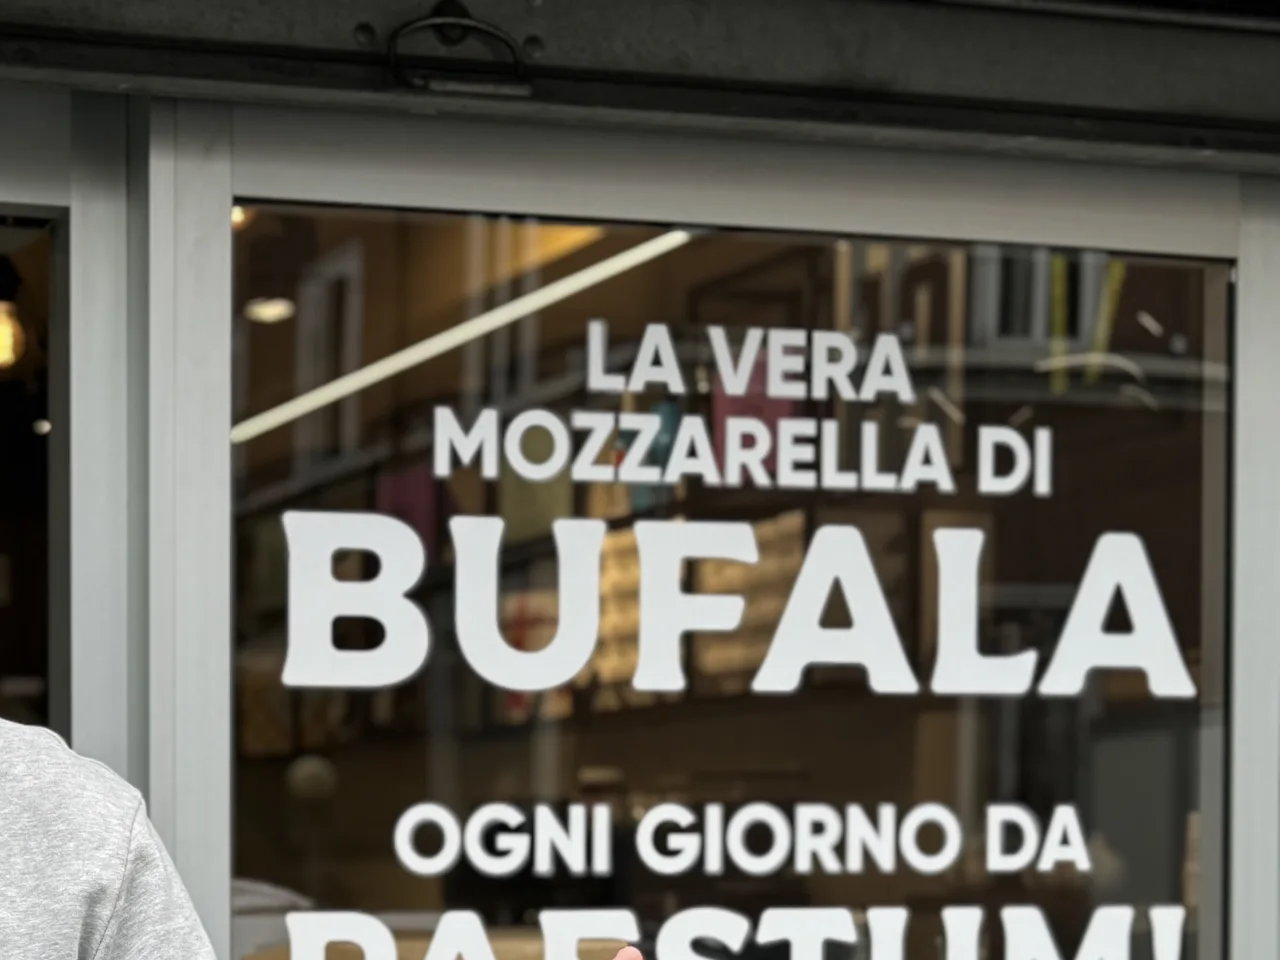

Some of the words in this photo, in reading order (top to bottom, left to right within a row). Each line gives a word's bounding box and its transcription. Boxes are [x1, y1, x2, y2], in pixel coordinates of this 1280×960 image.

[587, 320, 686, 395] LA
[707, 325, 917, 404] VERA
[433, 405, 956, 493] MOZZARELLA
[977, 425, 1053, 496] DI
[281, 510, 1198, 698] BUFALA
[393, 801, 612, 877] OGNI
[634, 801, 964, 876] GIORNO
[985, 803, 1093, 873] DA
